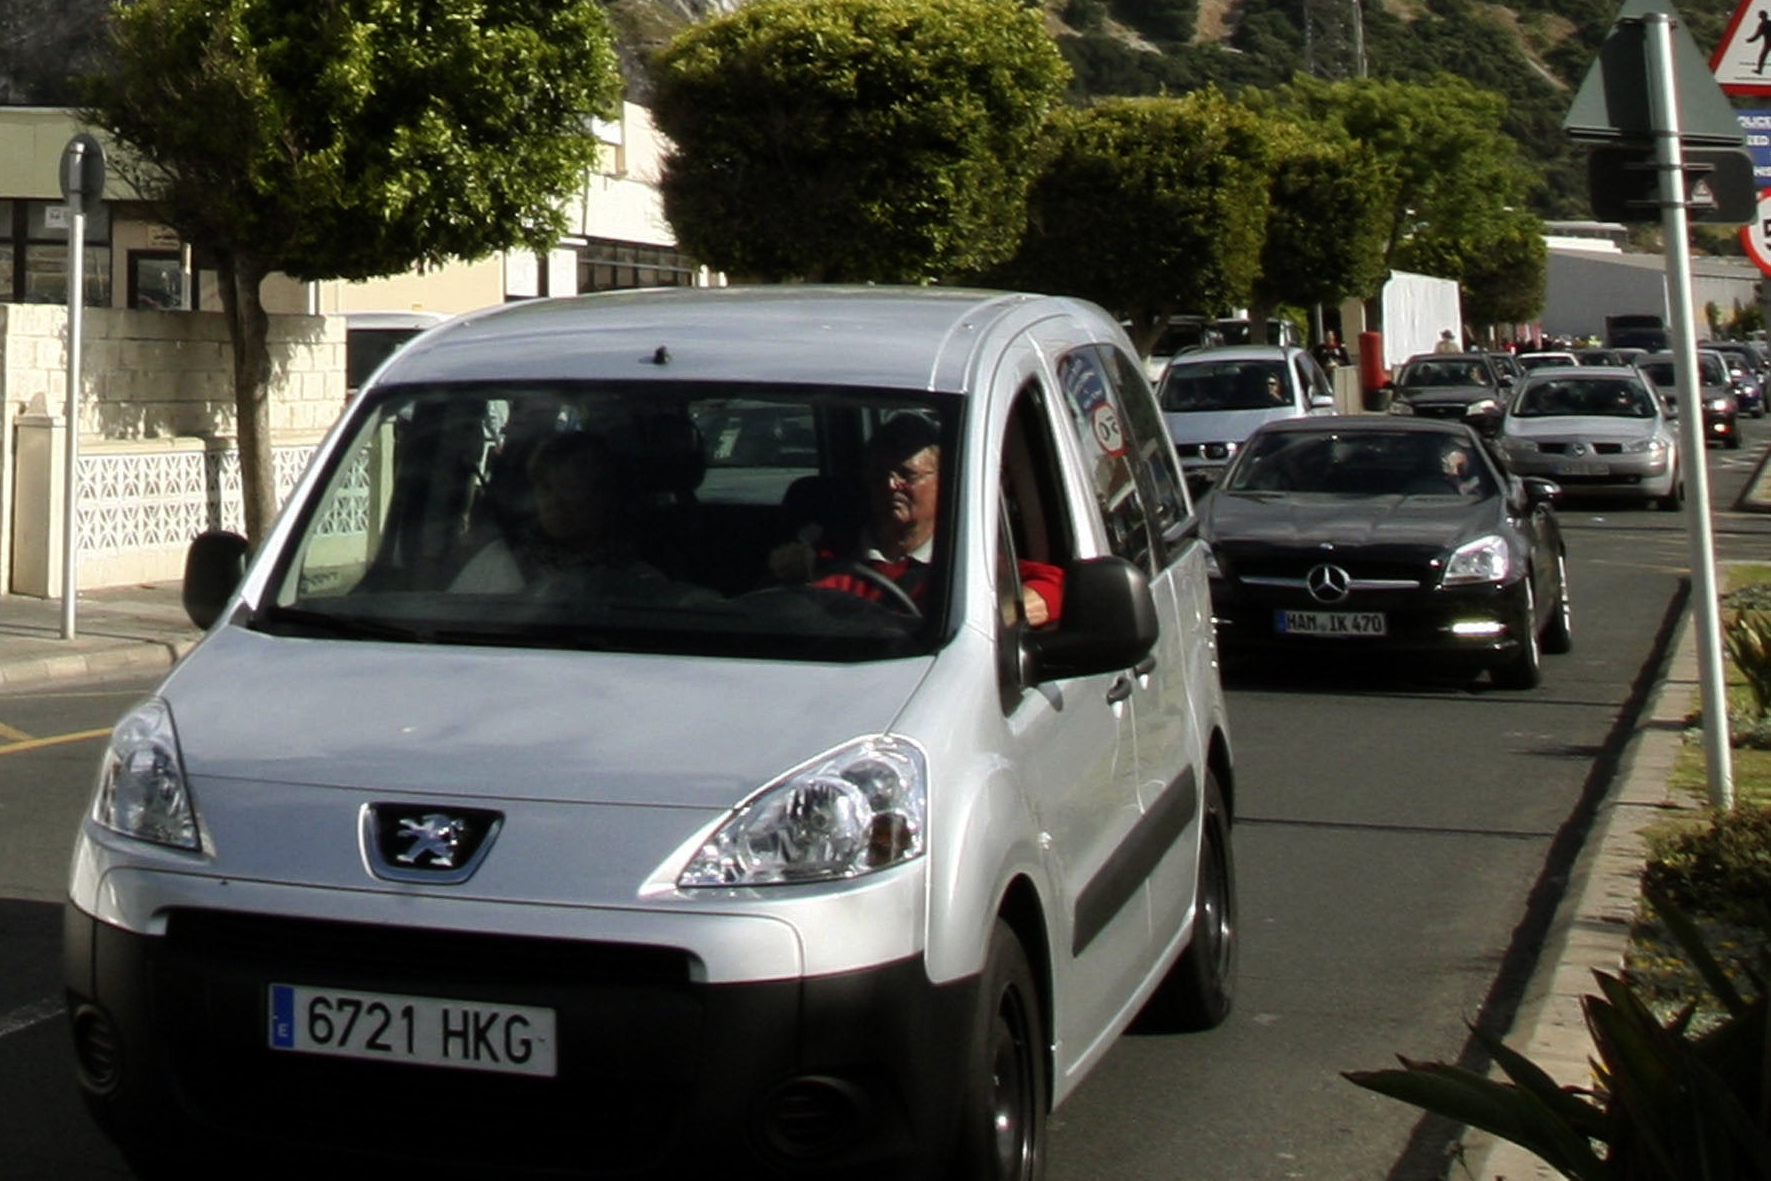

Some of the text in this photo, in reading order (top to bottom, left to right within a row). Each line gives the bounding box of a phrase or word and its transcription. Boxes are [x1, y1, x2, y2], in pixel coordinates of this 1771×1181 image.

[1287, 614, 1316, 630] HAM
[1352, 614, 1382, 632] 470
[308, 996, 533, 1064] 6721 HKG
